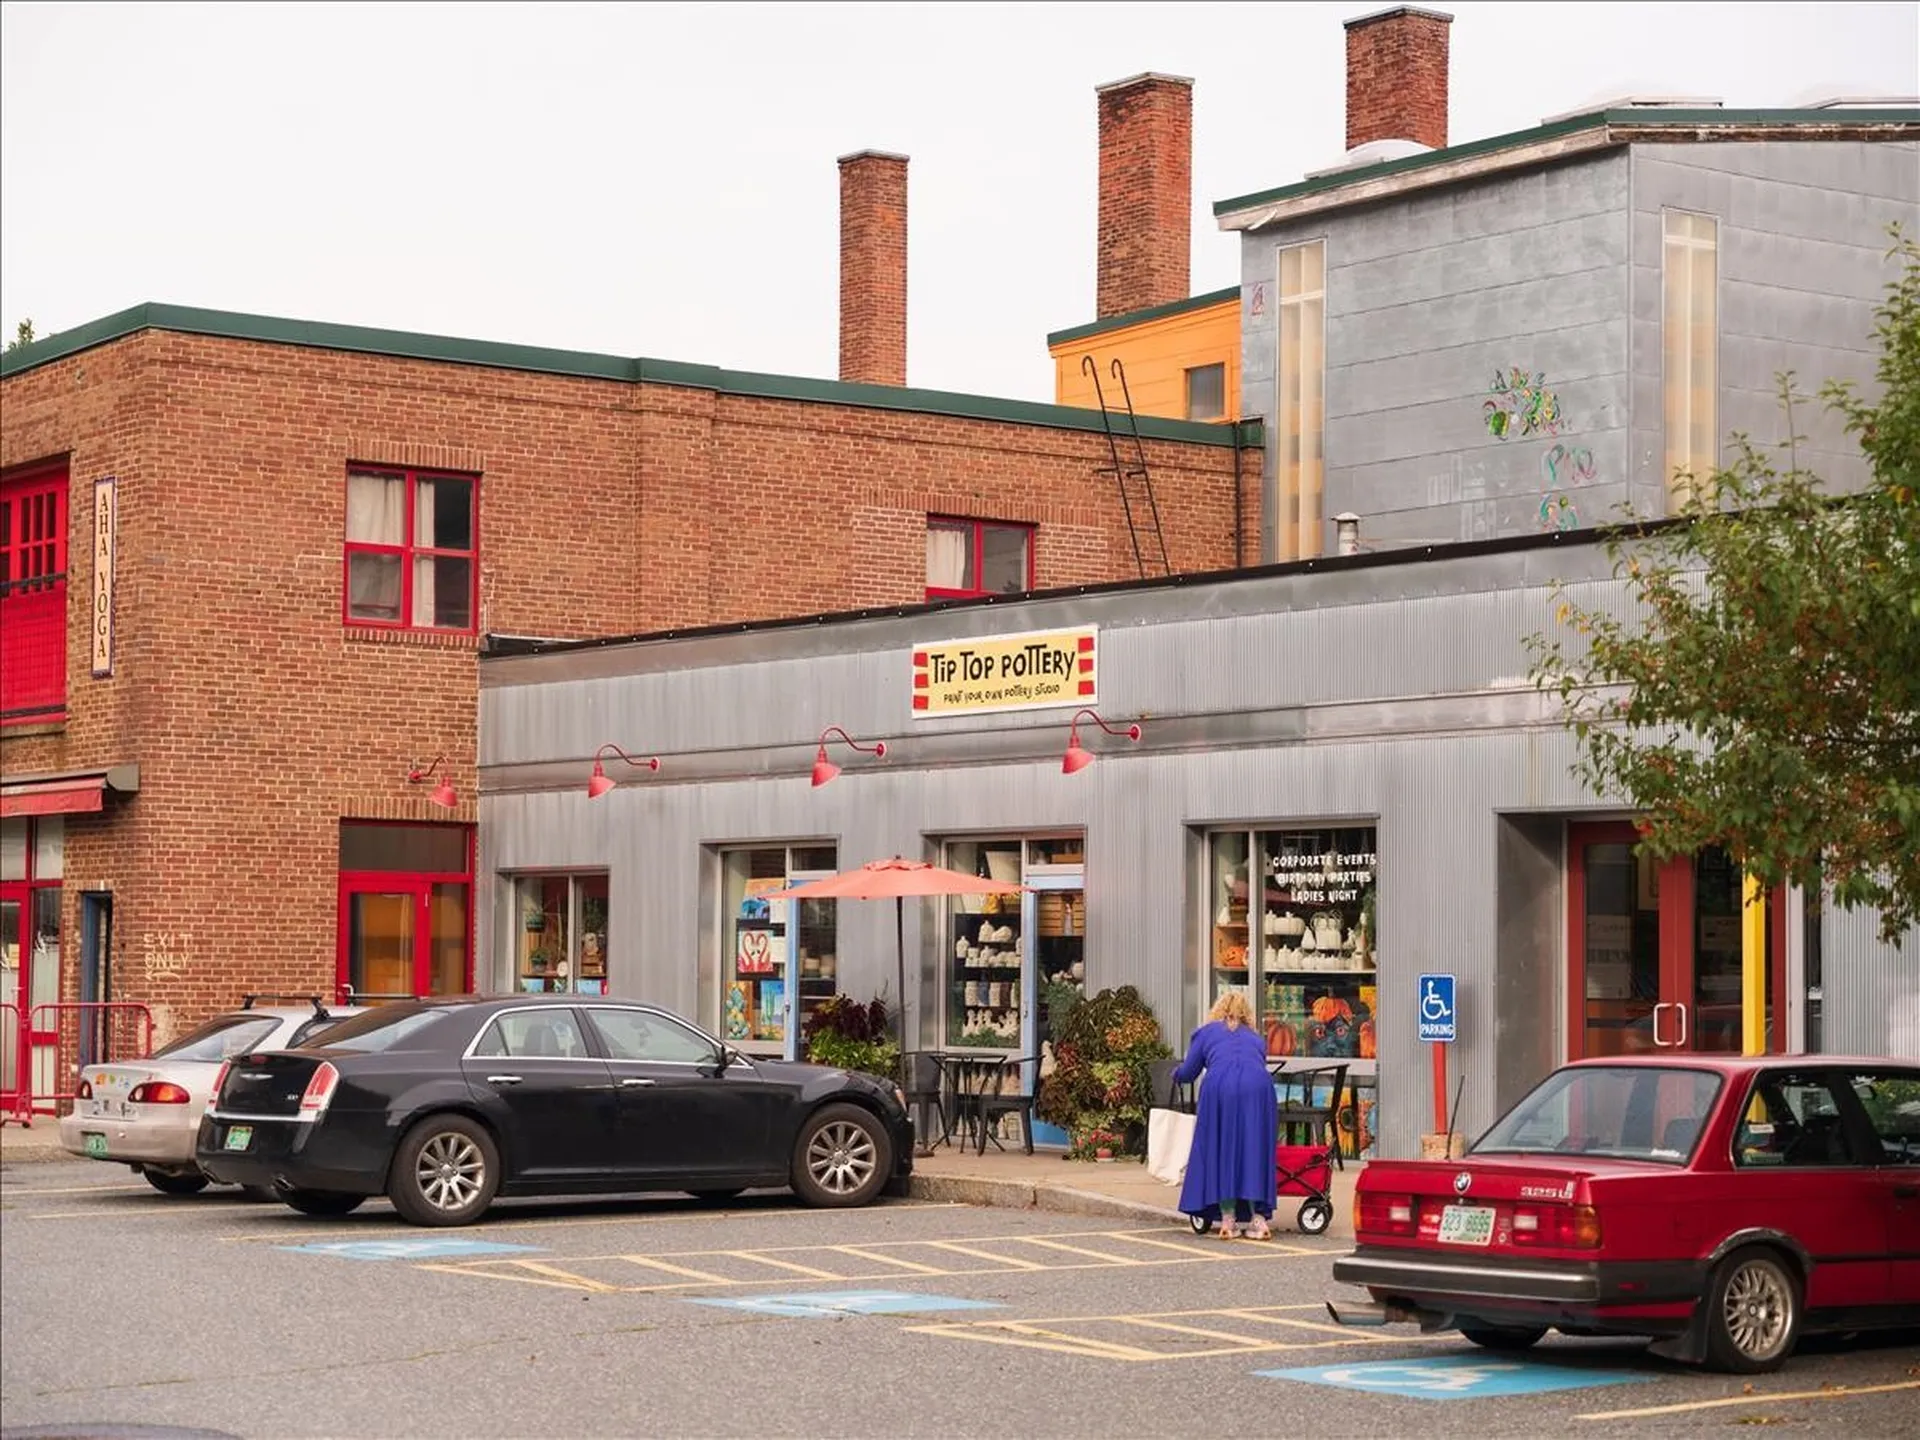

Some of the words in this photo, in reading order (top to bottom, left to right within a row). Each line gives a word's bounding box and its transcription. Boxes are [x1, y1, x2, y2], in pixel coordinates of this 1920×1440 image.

[98, 492, 109, 557] AHA
[97, 571, 108, 658] YOGA
[959, 650, 995, 681] TOP
[1001, 643, 1076, 682] POTTERY
[964, 690, 985, 704] YOUR
[984, 690, 1003, 700] OWN
[1004, 684, 1033, 699] POTTERY
[1034, 682, 1061, 696] STUDIO
[1272, 854, 1332, 868] CORPORATE
[1336, 853, 1377, 866] EVENTS
[1277, 872, 1326, 885] BIRTHDAY
[1328, 870, 1372, 884] PARTIES
[1291, 890, 1325, 904] LADIES
[1328, 889, 1358, 904] NIGHT
[143, 931, 193, 949] EXIT
[144, 952, 190, 969] ONLY
[1420, 1023, 1454, 1036] PARKING
